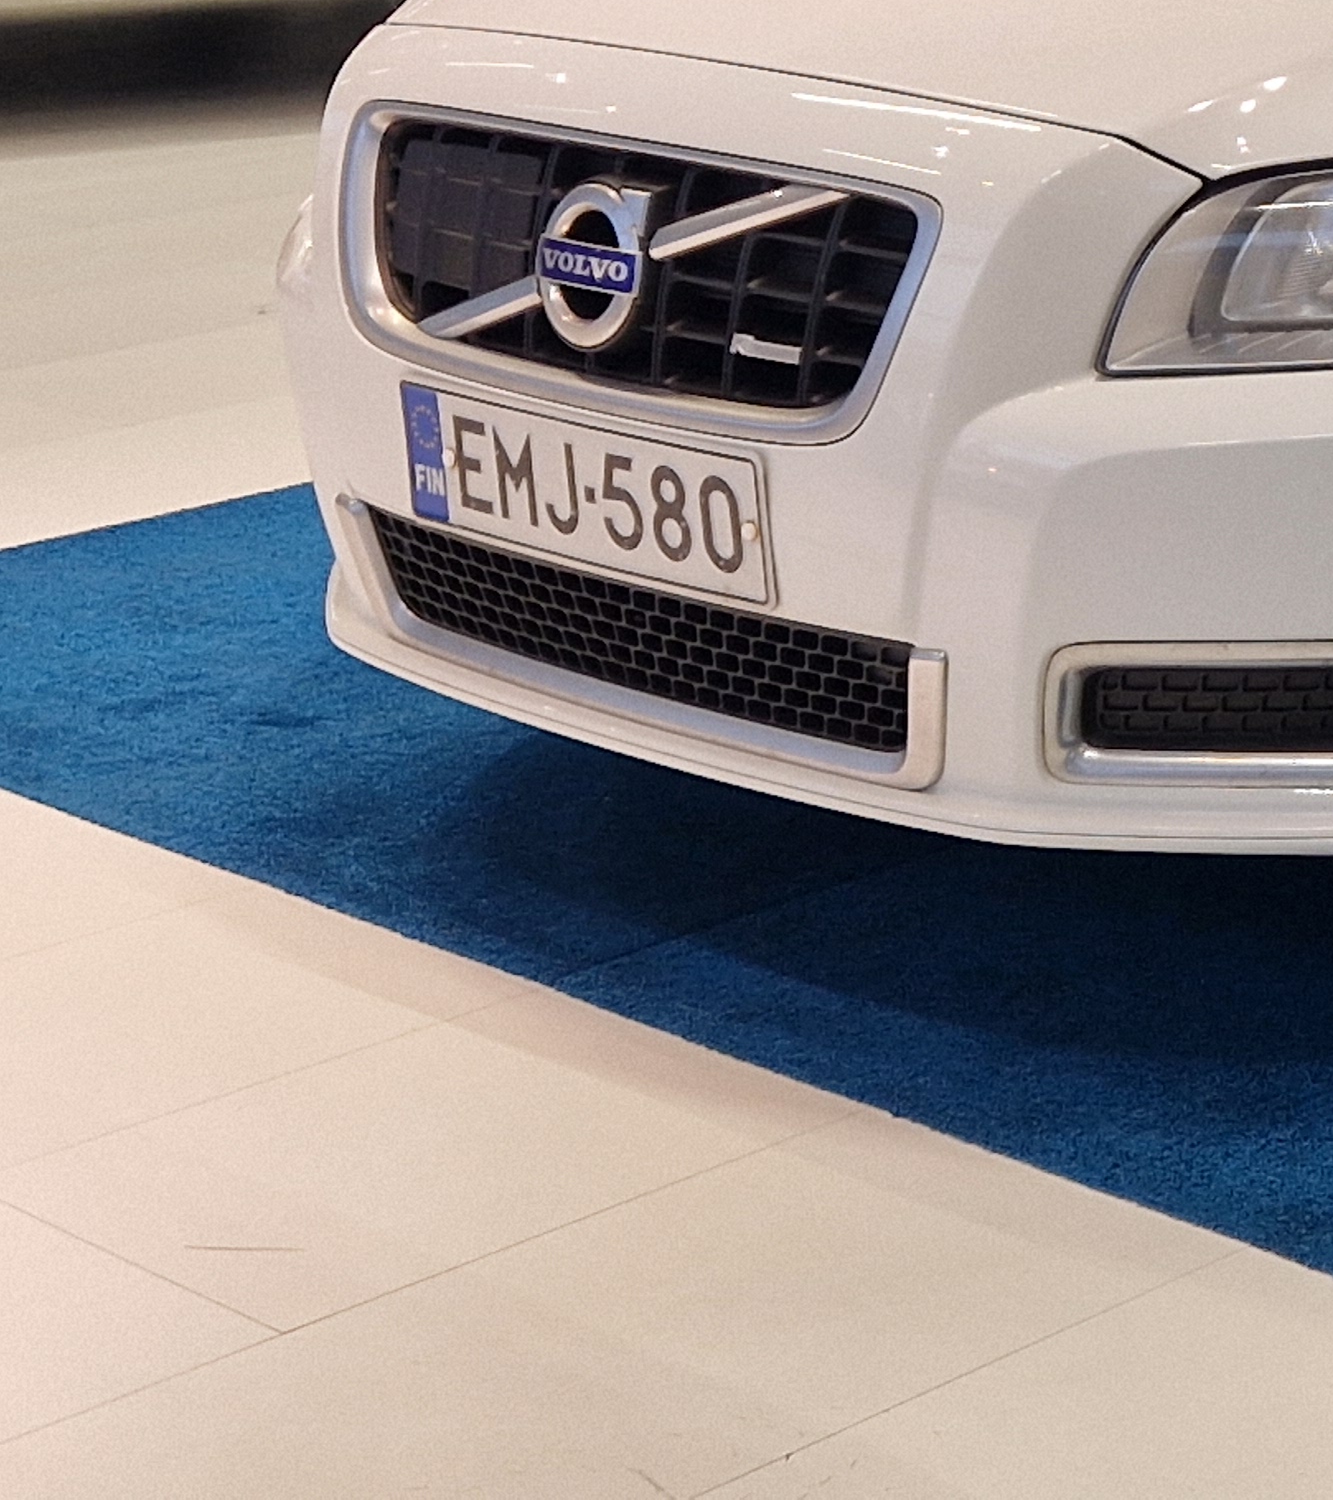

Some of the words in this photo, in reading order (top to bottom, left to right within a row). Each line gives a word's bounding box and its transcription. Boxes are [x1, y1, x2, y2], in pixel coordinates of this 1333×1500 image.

[543, 247, 628, 282] VOLVO
[414, 463, 446, 496] FIN
[453, 415, 743, 573] EMJ-580
